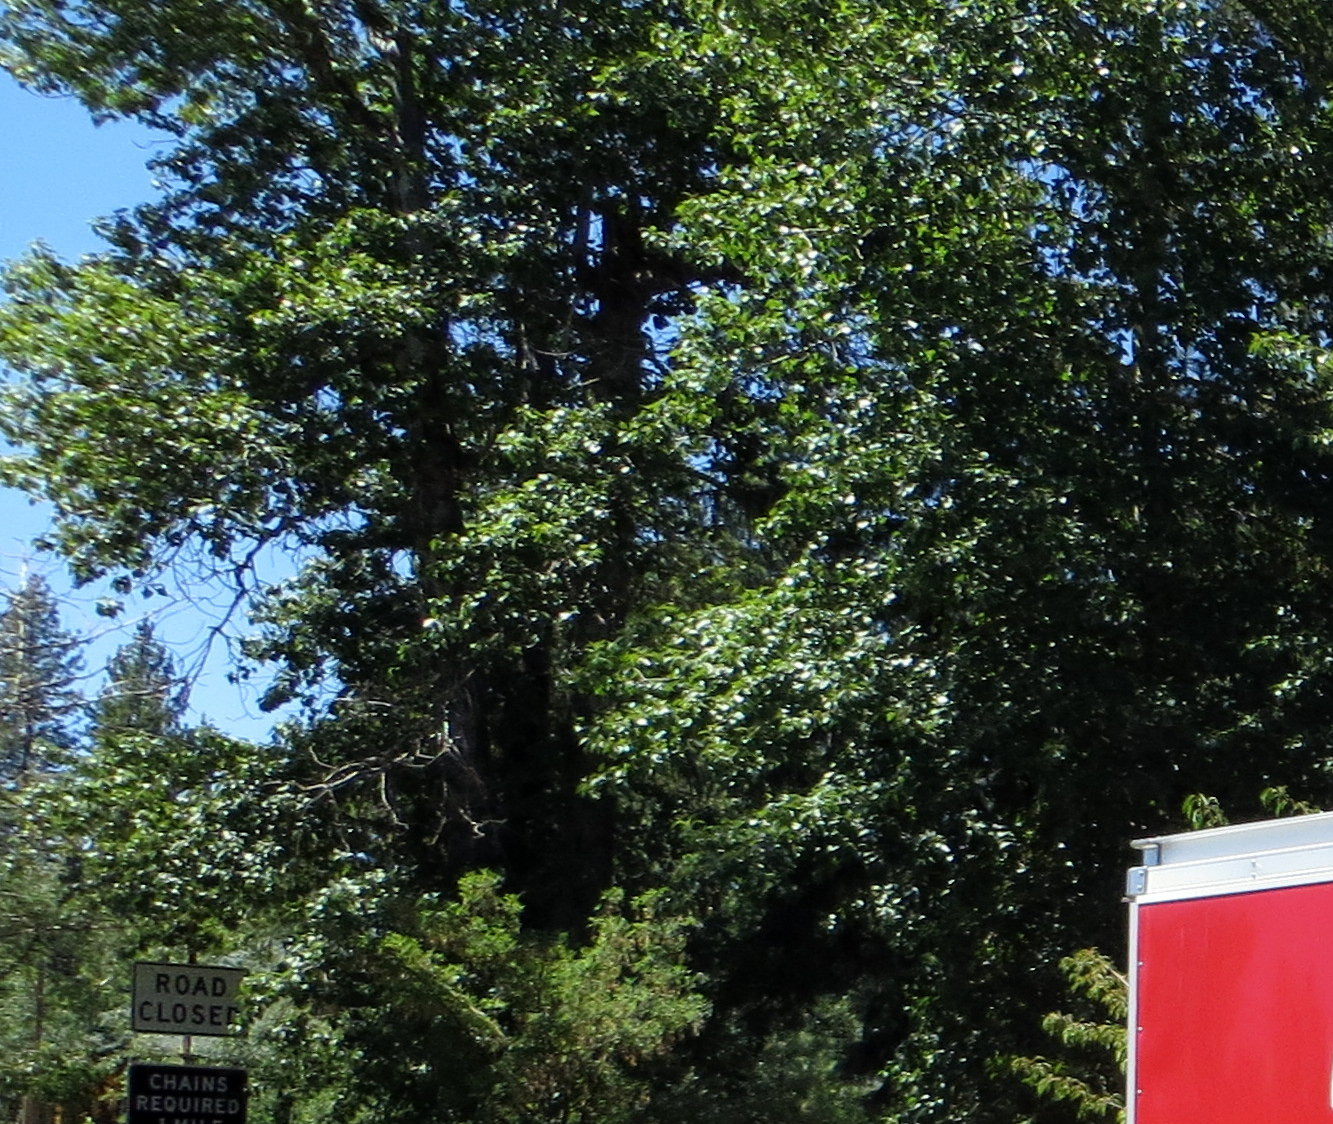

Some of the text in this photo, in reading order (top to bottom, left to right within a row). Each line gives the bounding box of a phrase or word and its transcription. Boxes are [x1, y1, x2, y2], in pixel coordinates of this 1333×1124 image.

[156, 973, 227, 997] ROAD
[150, 1073, 229, 1093] CHAINS
[136, 1095, 240, 1115] REQUIRED
